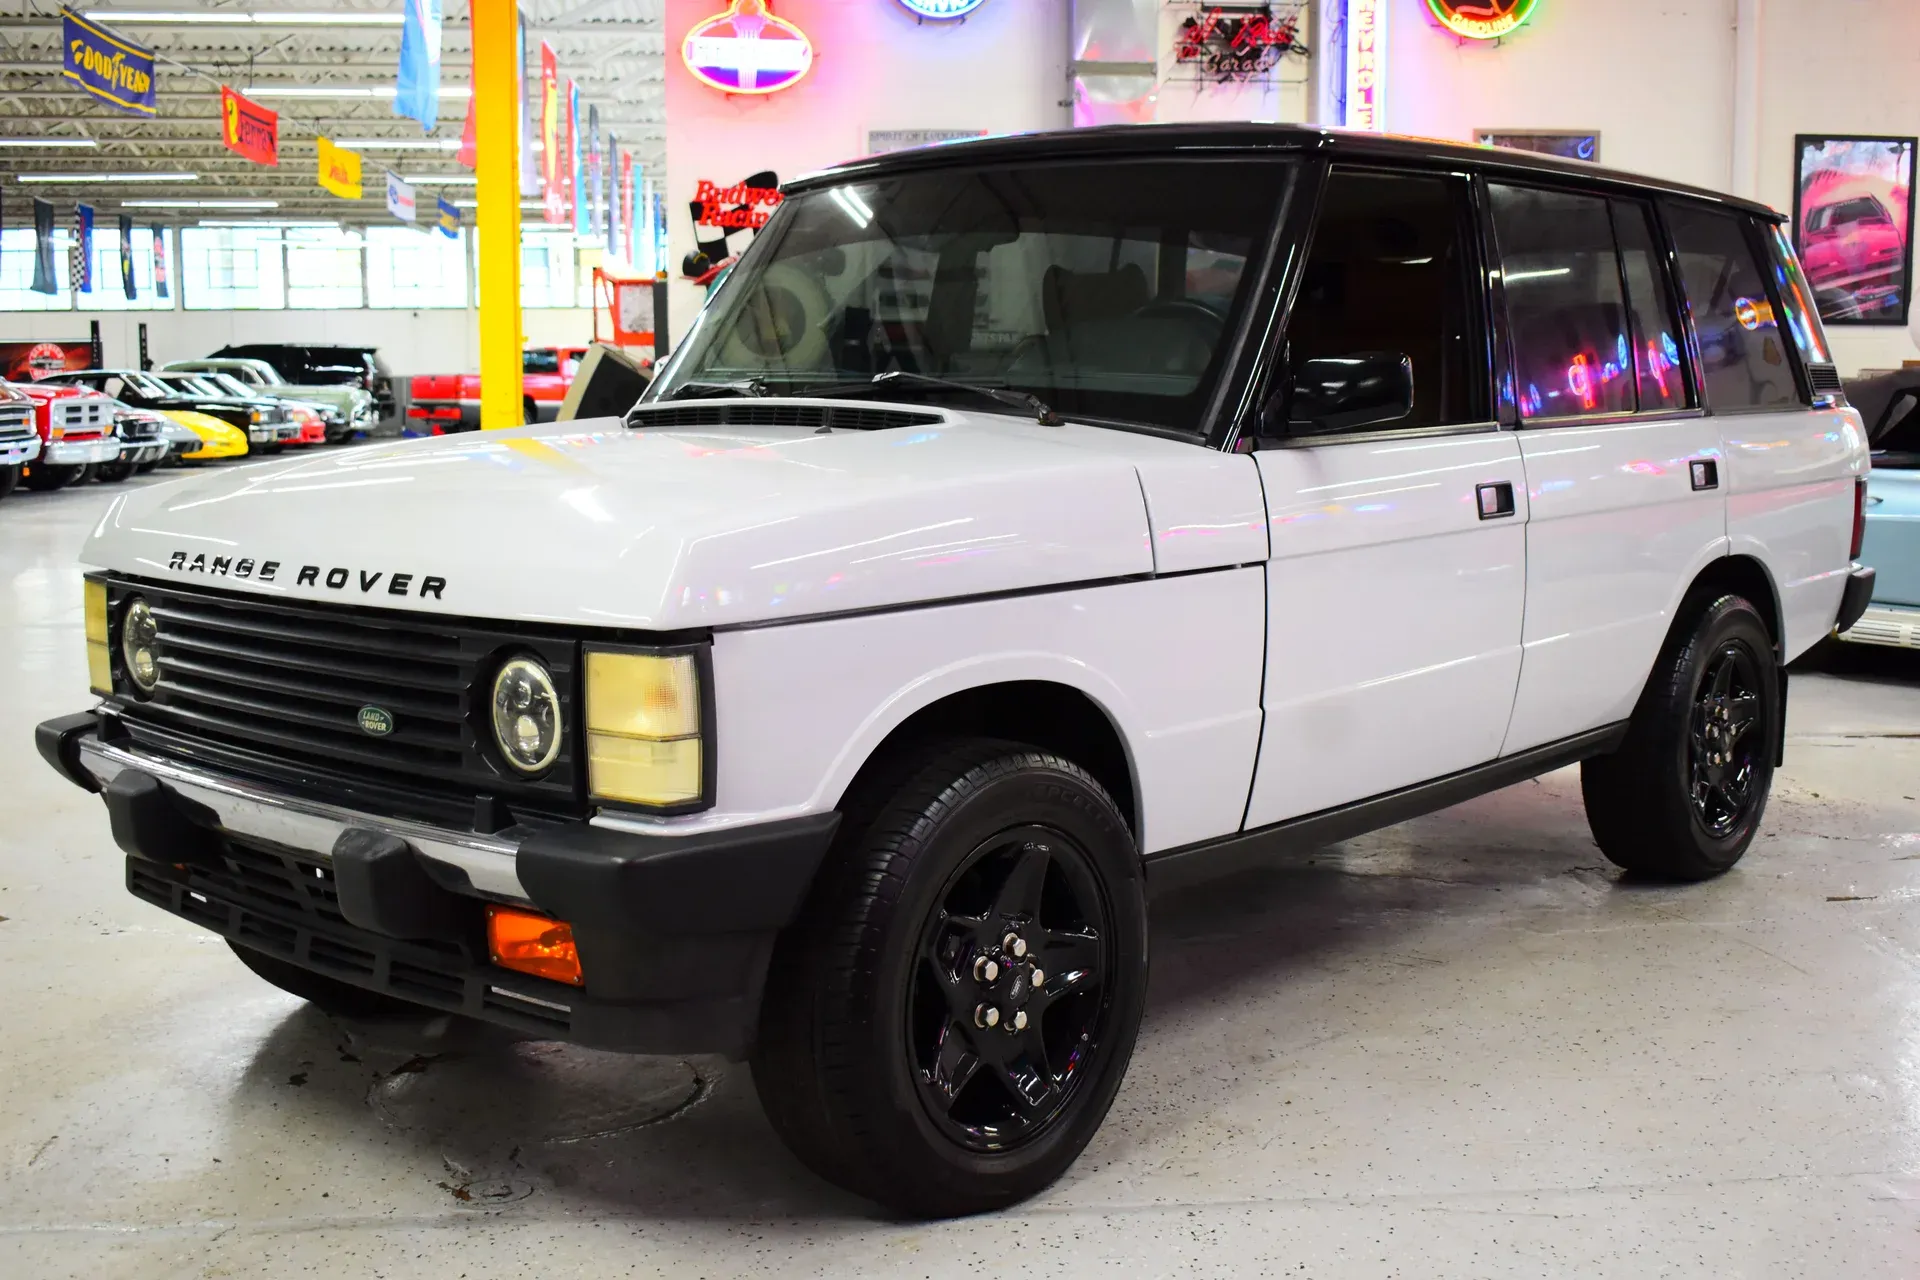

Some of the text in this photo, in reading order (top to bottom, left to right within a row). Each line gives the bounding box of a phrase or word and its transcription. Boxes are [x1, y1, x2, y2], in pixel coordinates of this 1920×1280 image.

[167, 550, 448, 600] RANGE ROVER
[362, 710, 380, 722] LAND
[364, 720, 387, 732] ROVER
